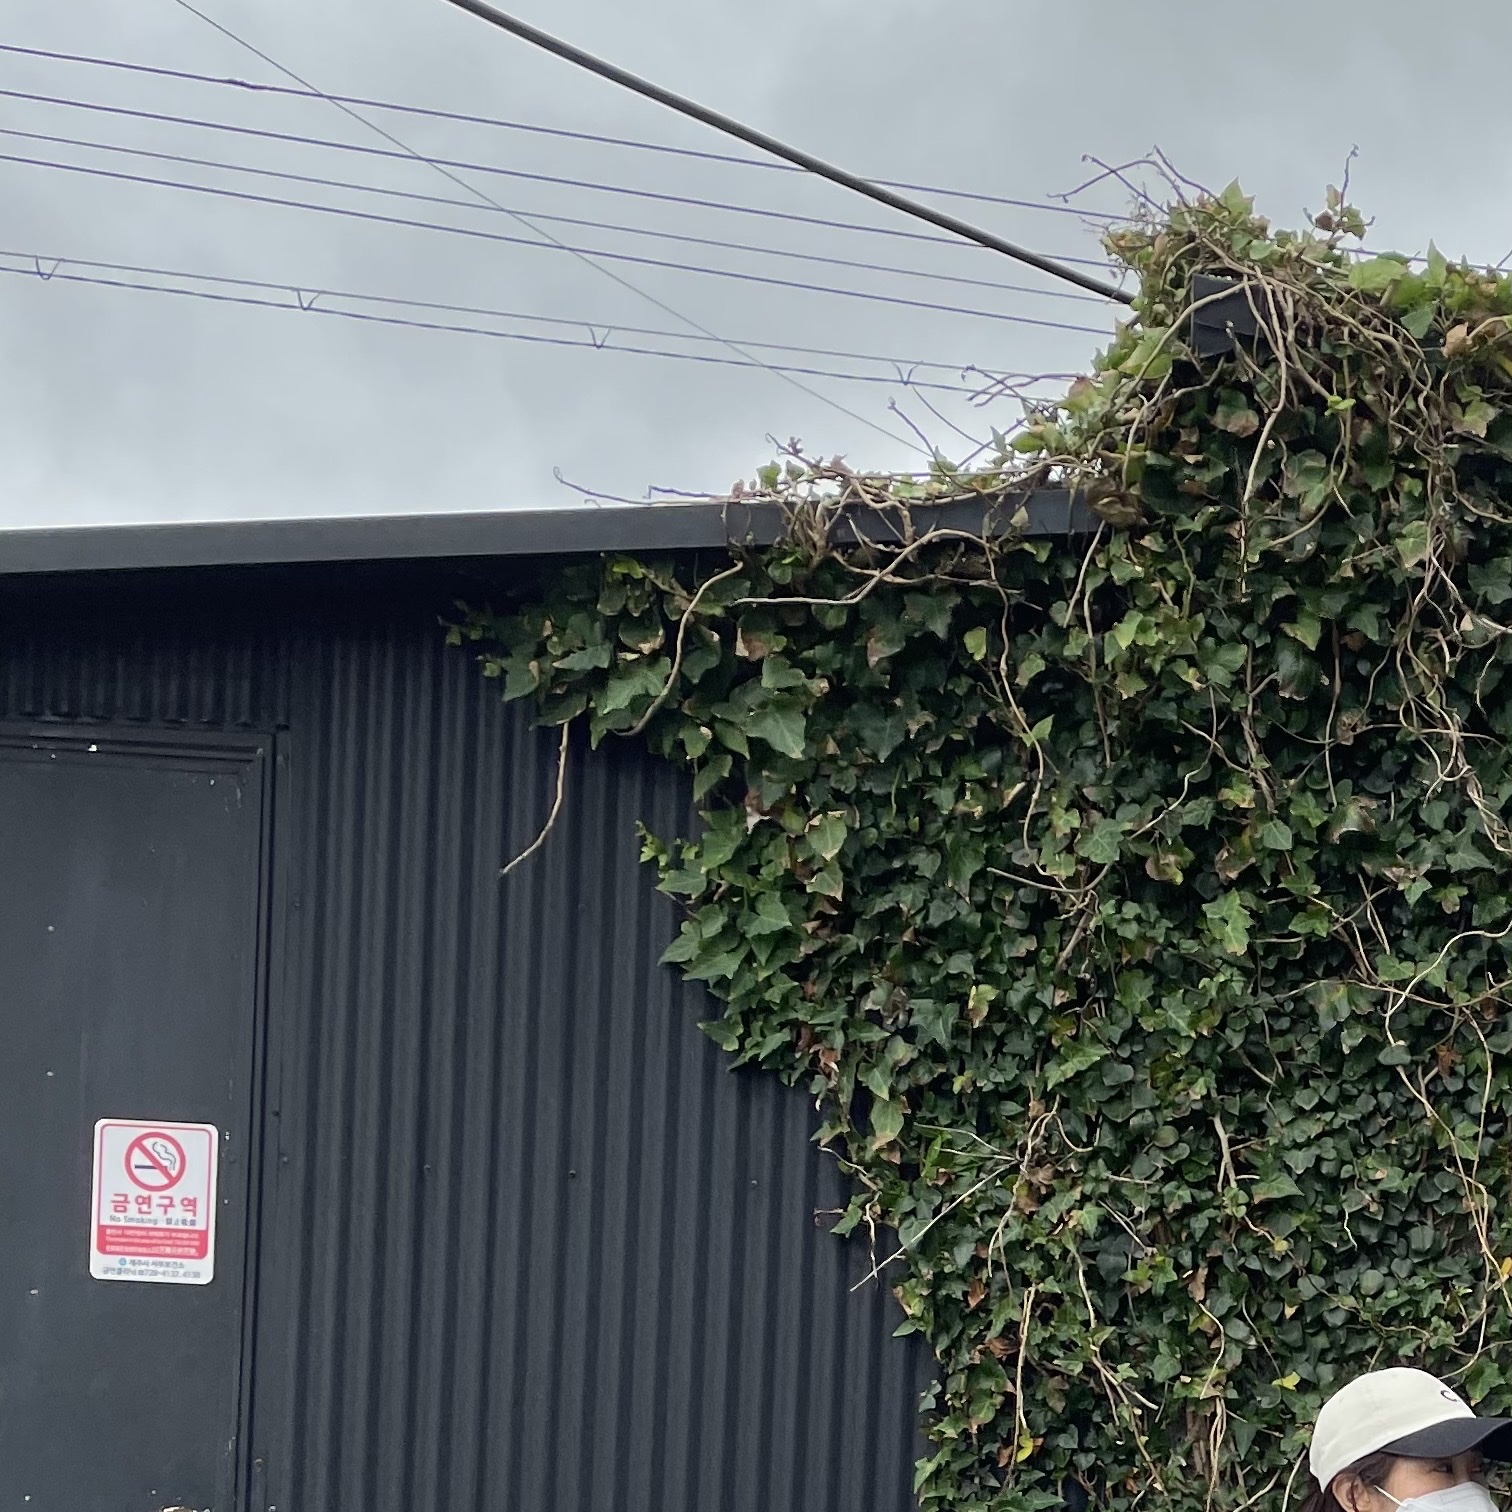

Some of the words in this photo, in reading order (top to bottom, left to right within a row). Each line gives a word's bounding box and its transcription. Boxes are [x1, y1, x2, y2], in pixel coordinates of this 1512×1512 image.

[111, 1193, 197, 1217] 금연구역
[110, 1215, 121, 1223] No
[124, 1216, 158, 1226] Smoking
